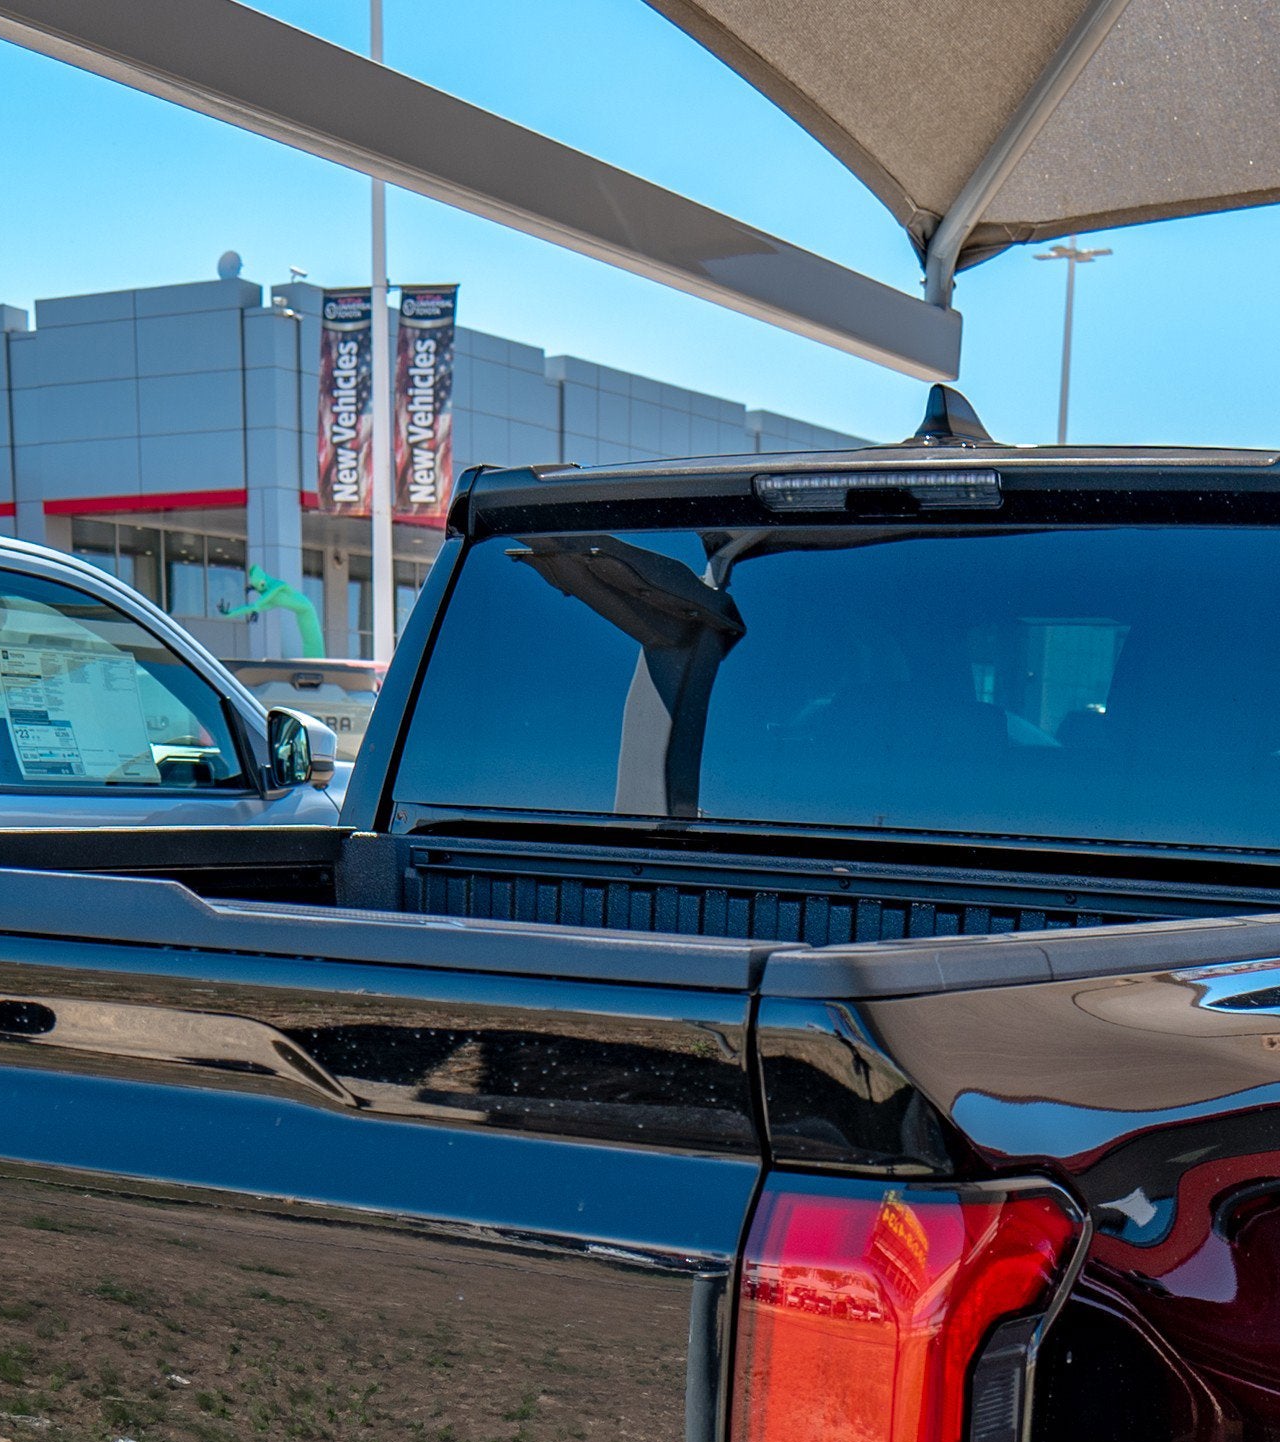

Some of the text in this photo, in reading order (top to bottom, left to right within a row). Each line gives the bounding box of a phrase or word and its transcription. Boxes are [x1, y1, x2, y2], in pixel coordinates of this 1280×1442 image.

[332, 340, 359, 502] New Vehicles
[407, 338, 437, 503] New Vehicles
